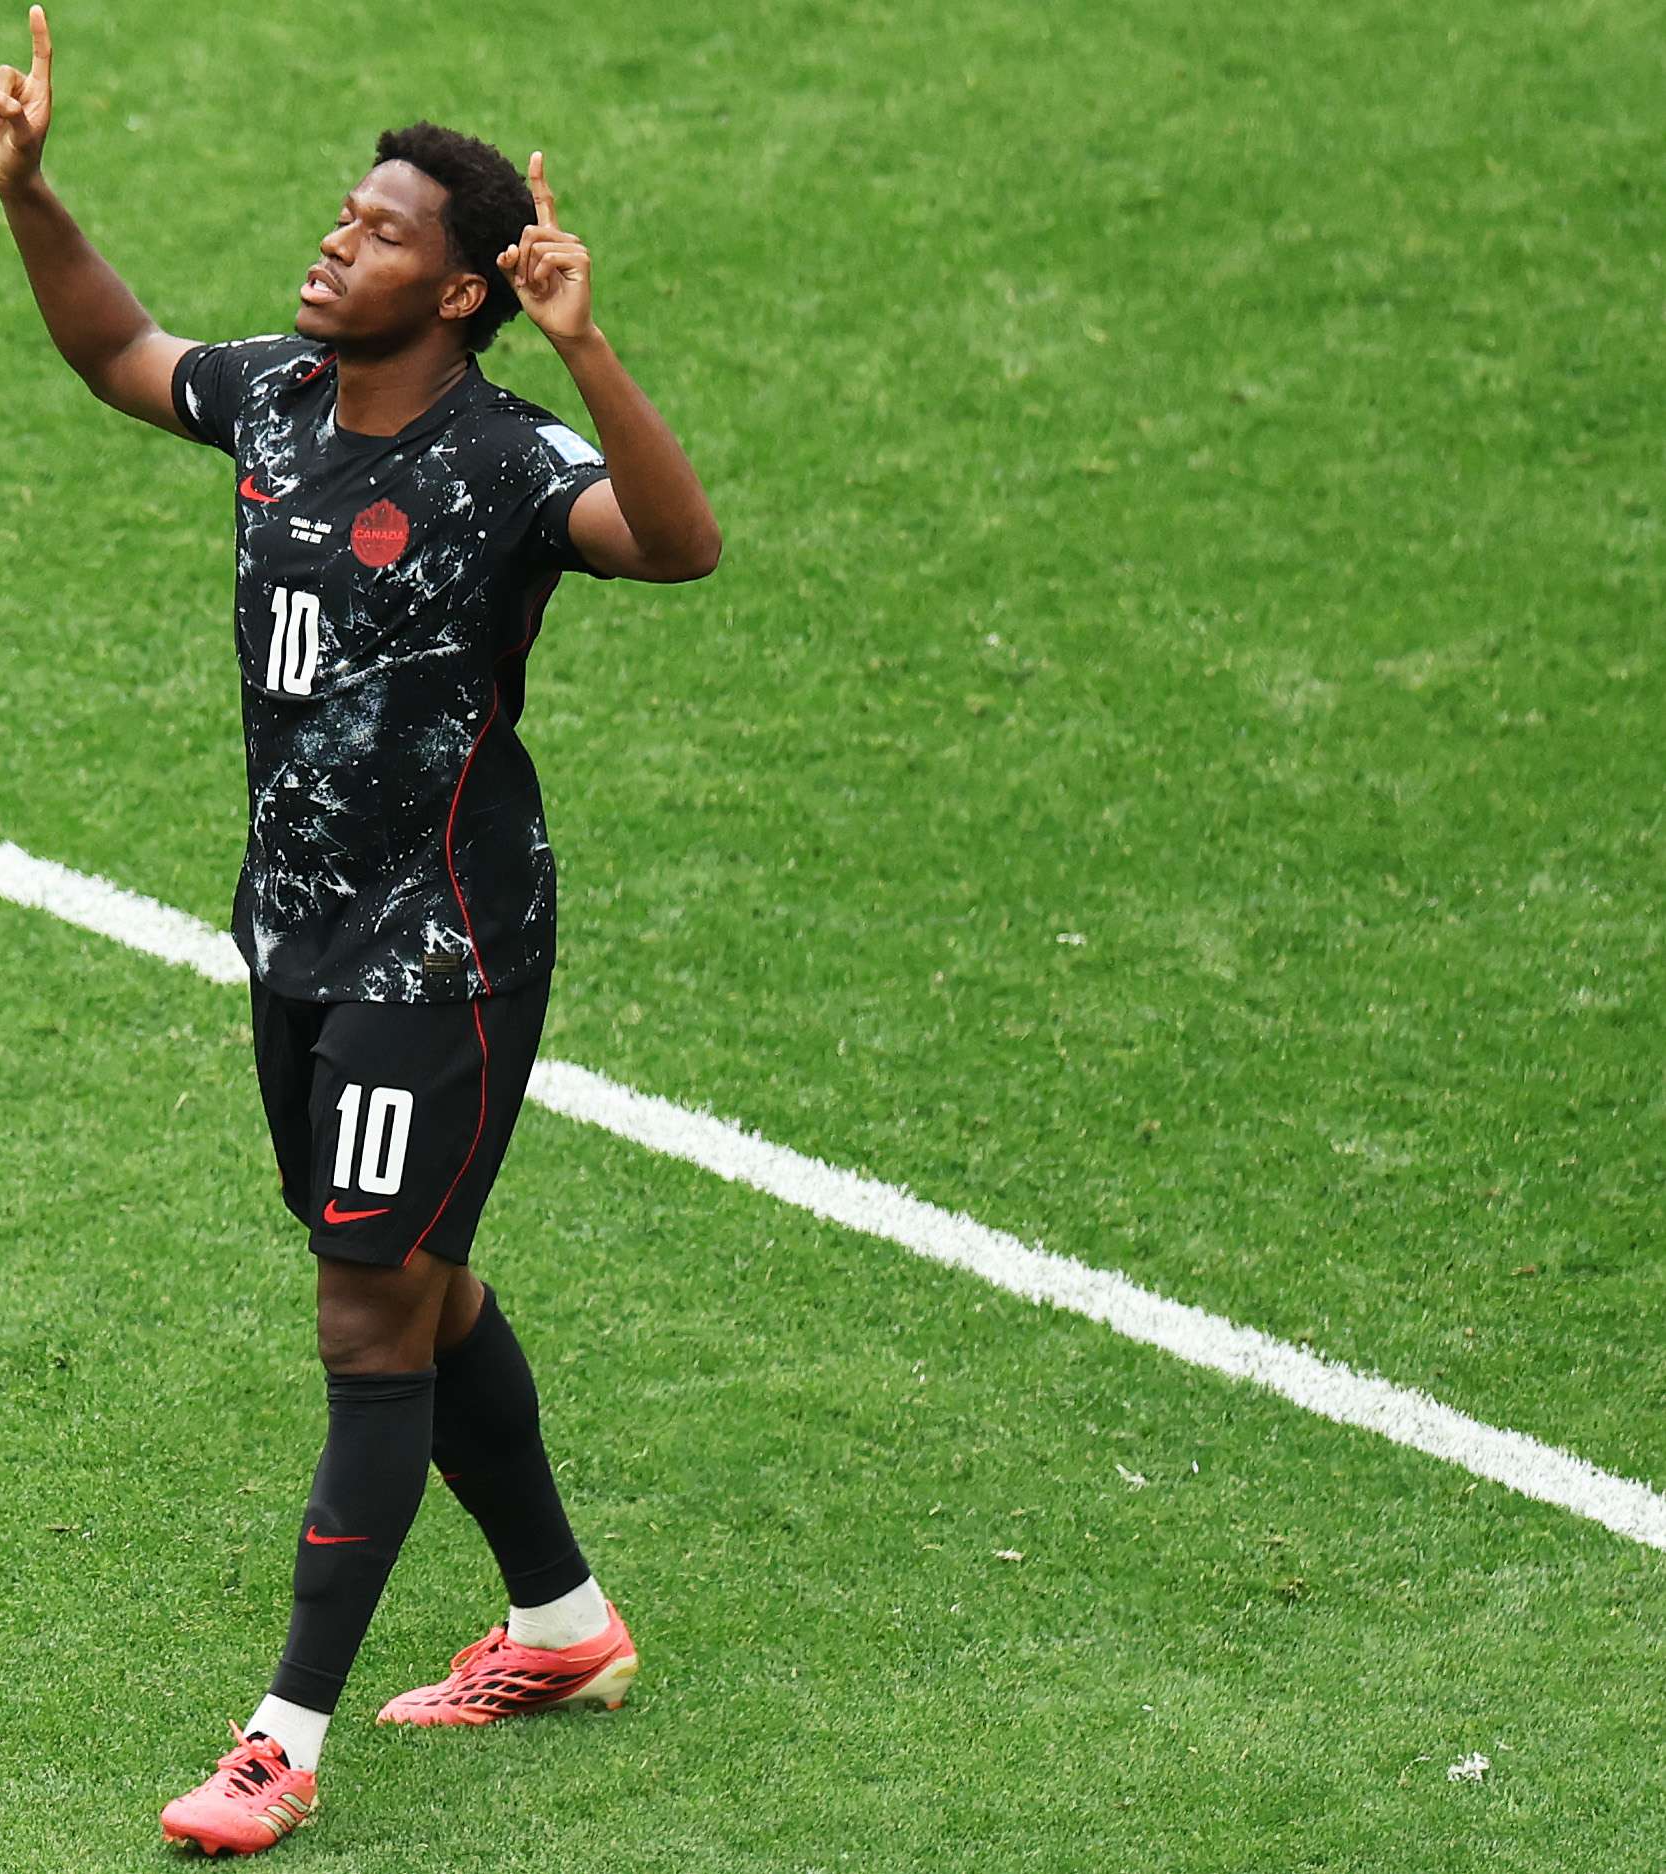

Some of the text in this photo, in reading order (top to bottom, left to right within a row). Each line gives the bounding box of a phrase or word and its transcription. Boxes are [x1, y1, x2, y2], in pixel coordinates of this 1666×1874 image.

[354, 528, 405, 541] CANADA
[266, 587, 320, 696] 10
[333, 1083, 414, 1195] 10
